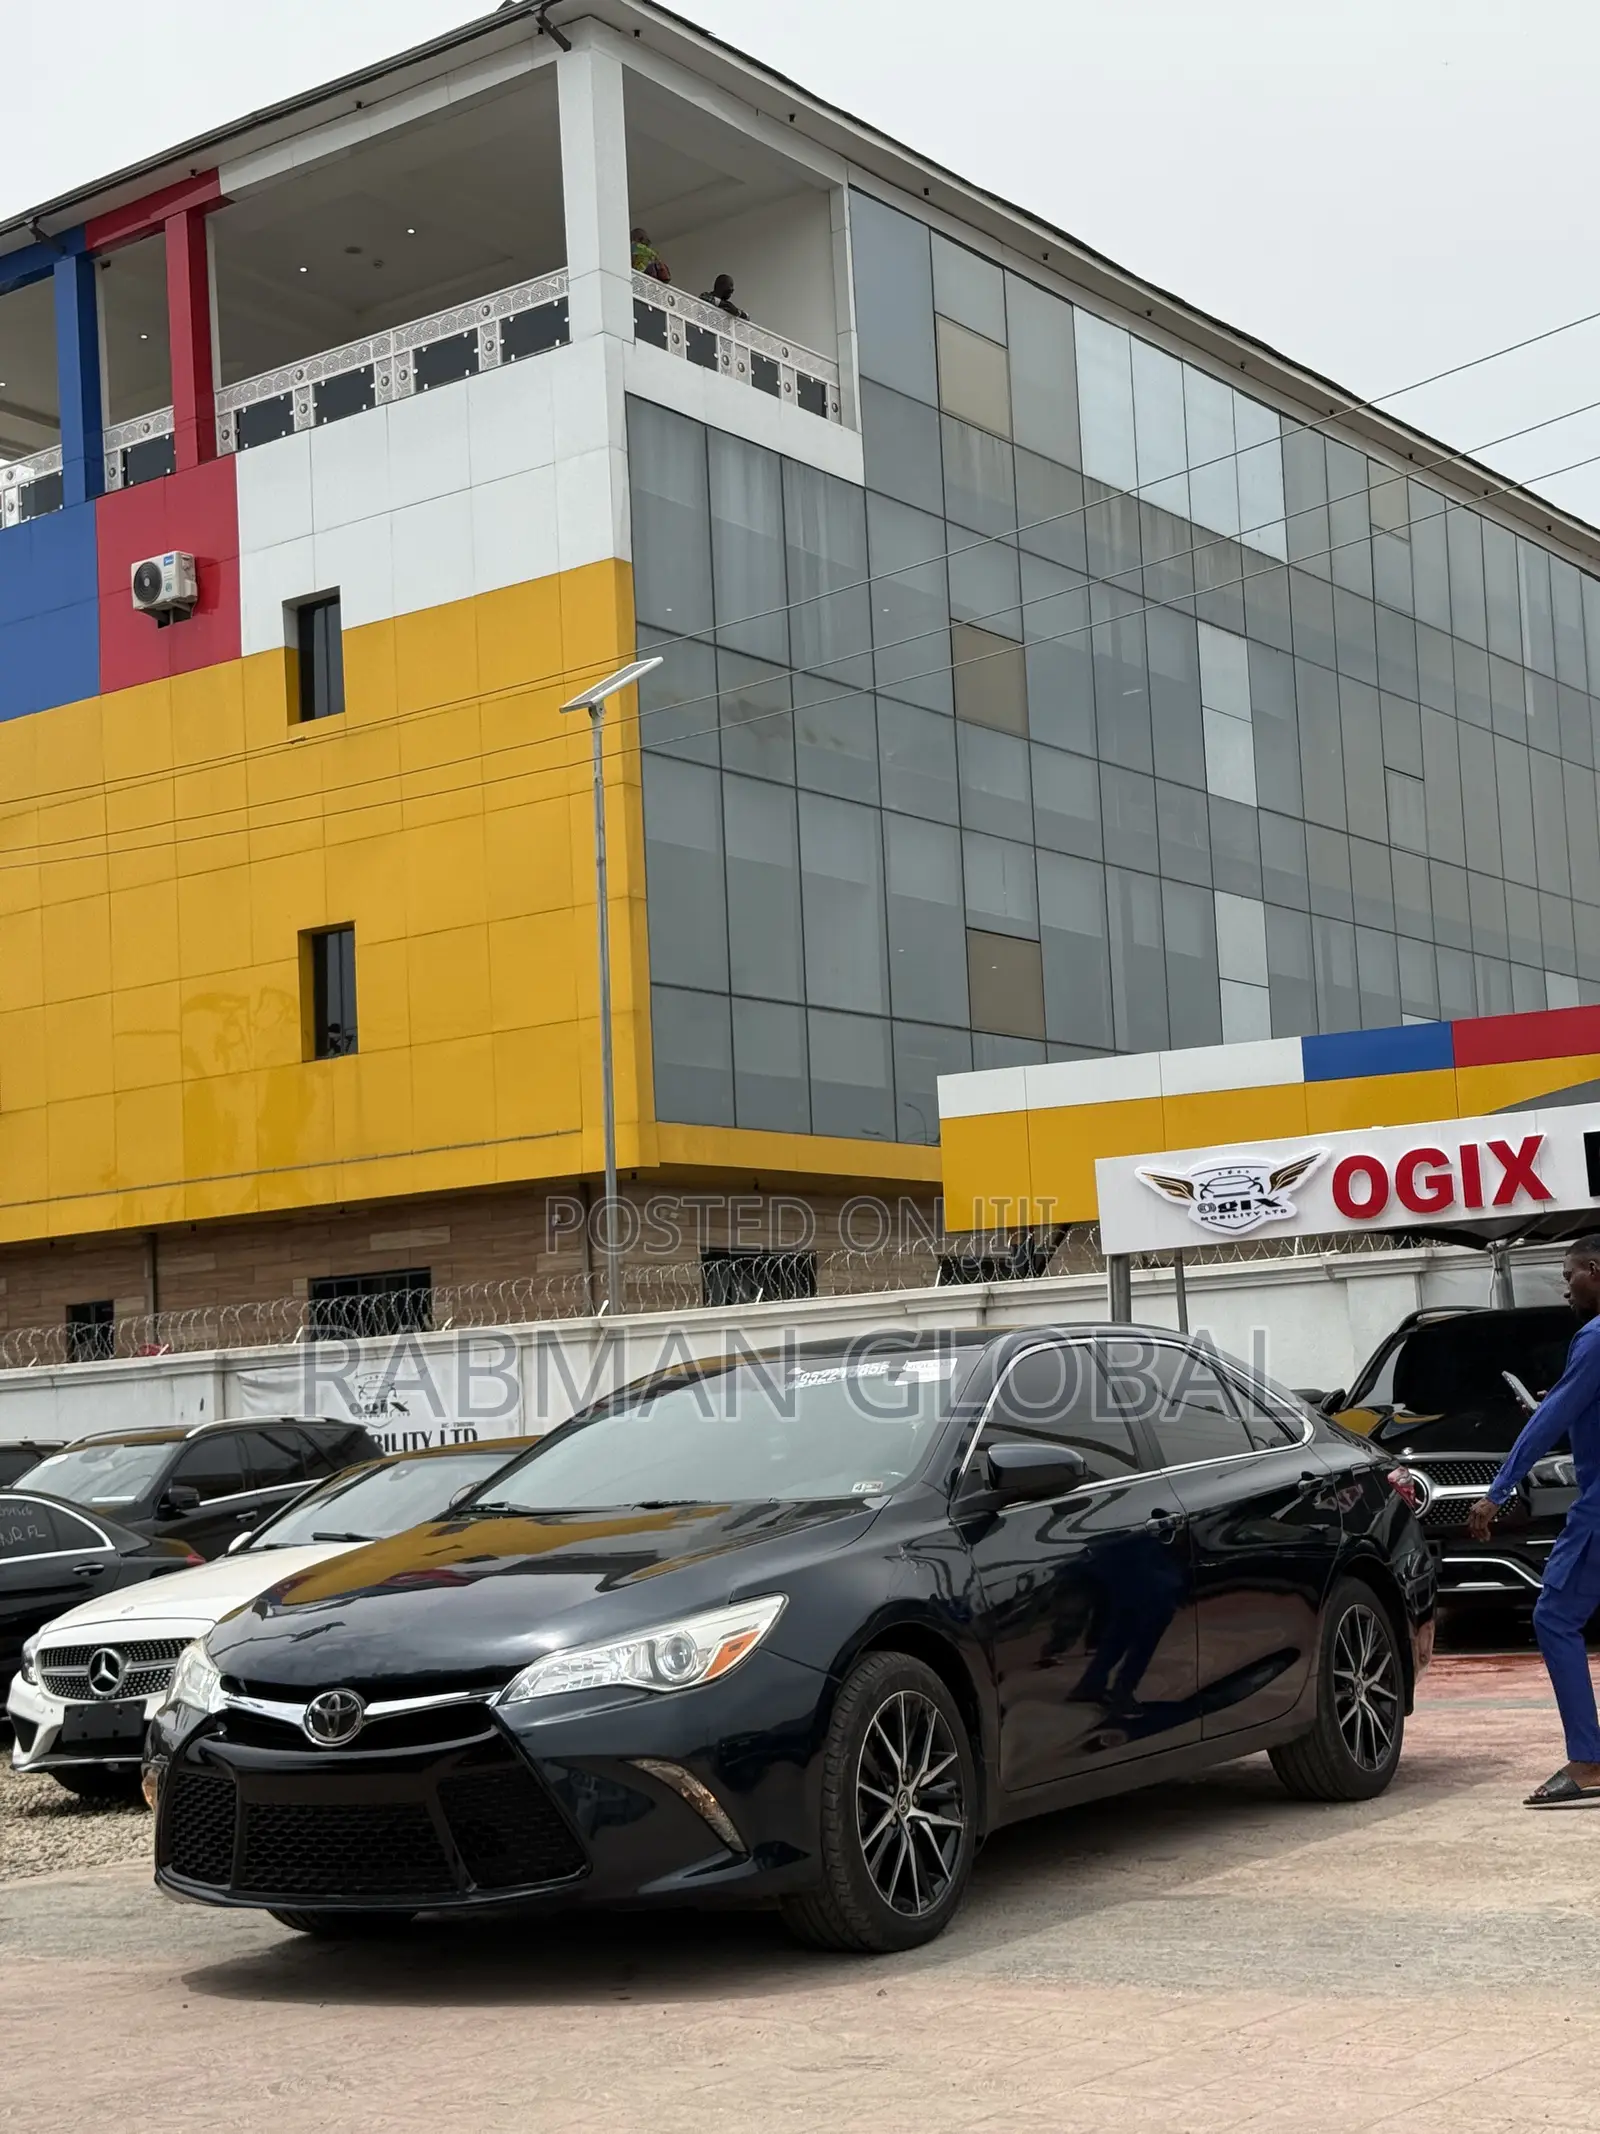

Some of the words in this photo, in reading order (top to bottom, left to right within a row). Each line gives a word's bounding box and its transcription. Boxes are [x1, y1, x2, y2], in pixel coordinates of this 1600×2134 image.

[1332, 1135, 1554, 1219] OGIX
[1201, 1211, 1260, 1220] MOBILITY
[371, 1431, 432, 1452] BILITY
